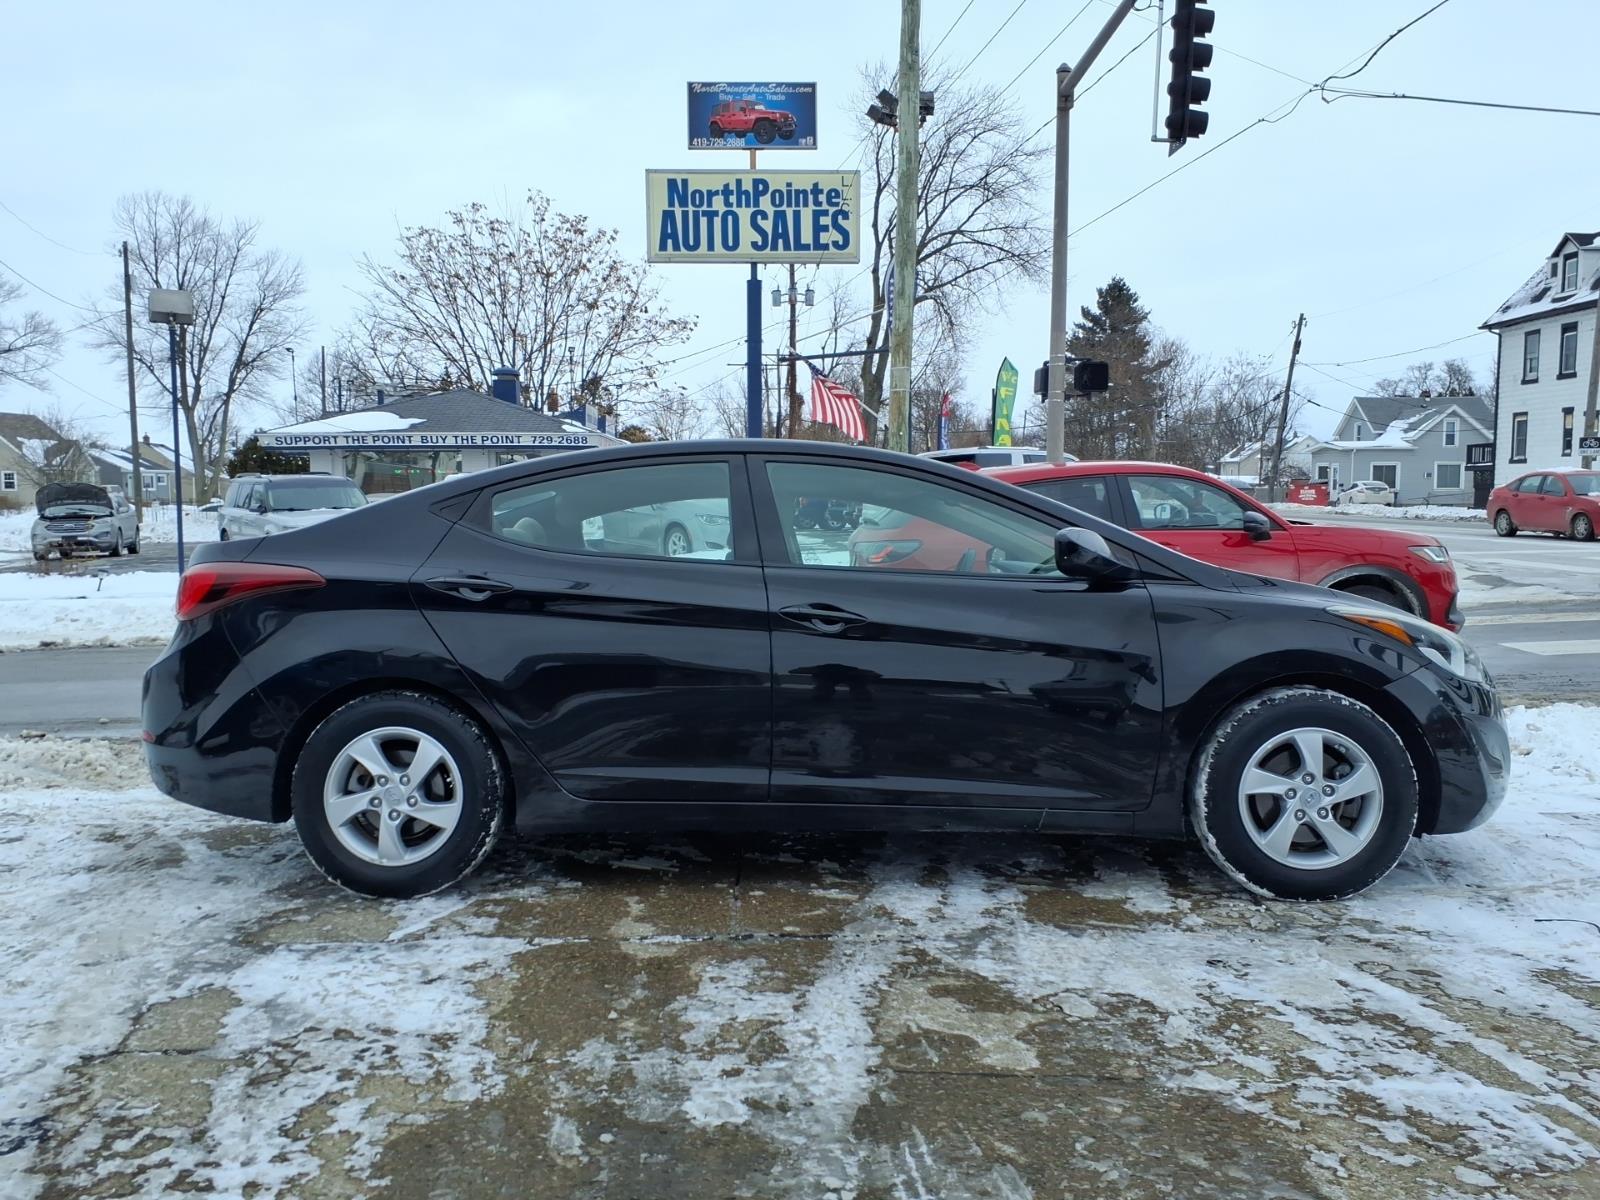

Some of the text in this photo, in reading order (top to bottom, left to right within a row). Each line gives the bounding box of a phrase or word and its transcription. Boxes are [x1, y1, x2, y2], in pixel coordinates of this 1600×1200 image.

[691, 83, 813, 93] NorthPointeAutoSales.com
[719, 93, 733, 102] Buy
[742, 93, 756, 101] Sell
[765, 93, 786, 101] Trade
[692, 138, 746, 147] 419-729-2688
[667, 178, 841, 209] NorthPointe
[658, 208, 850, 252] AUTO SALES
[274, 435, 589, 446] SUPPORT THE POINT BUY THE POINT 729-2688
